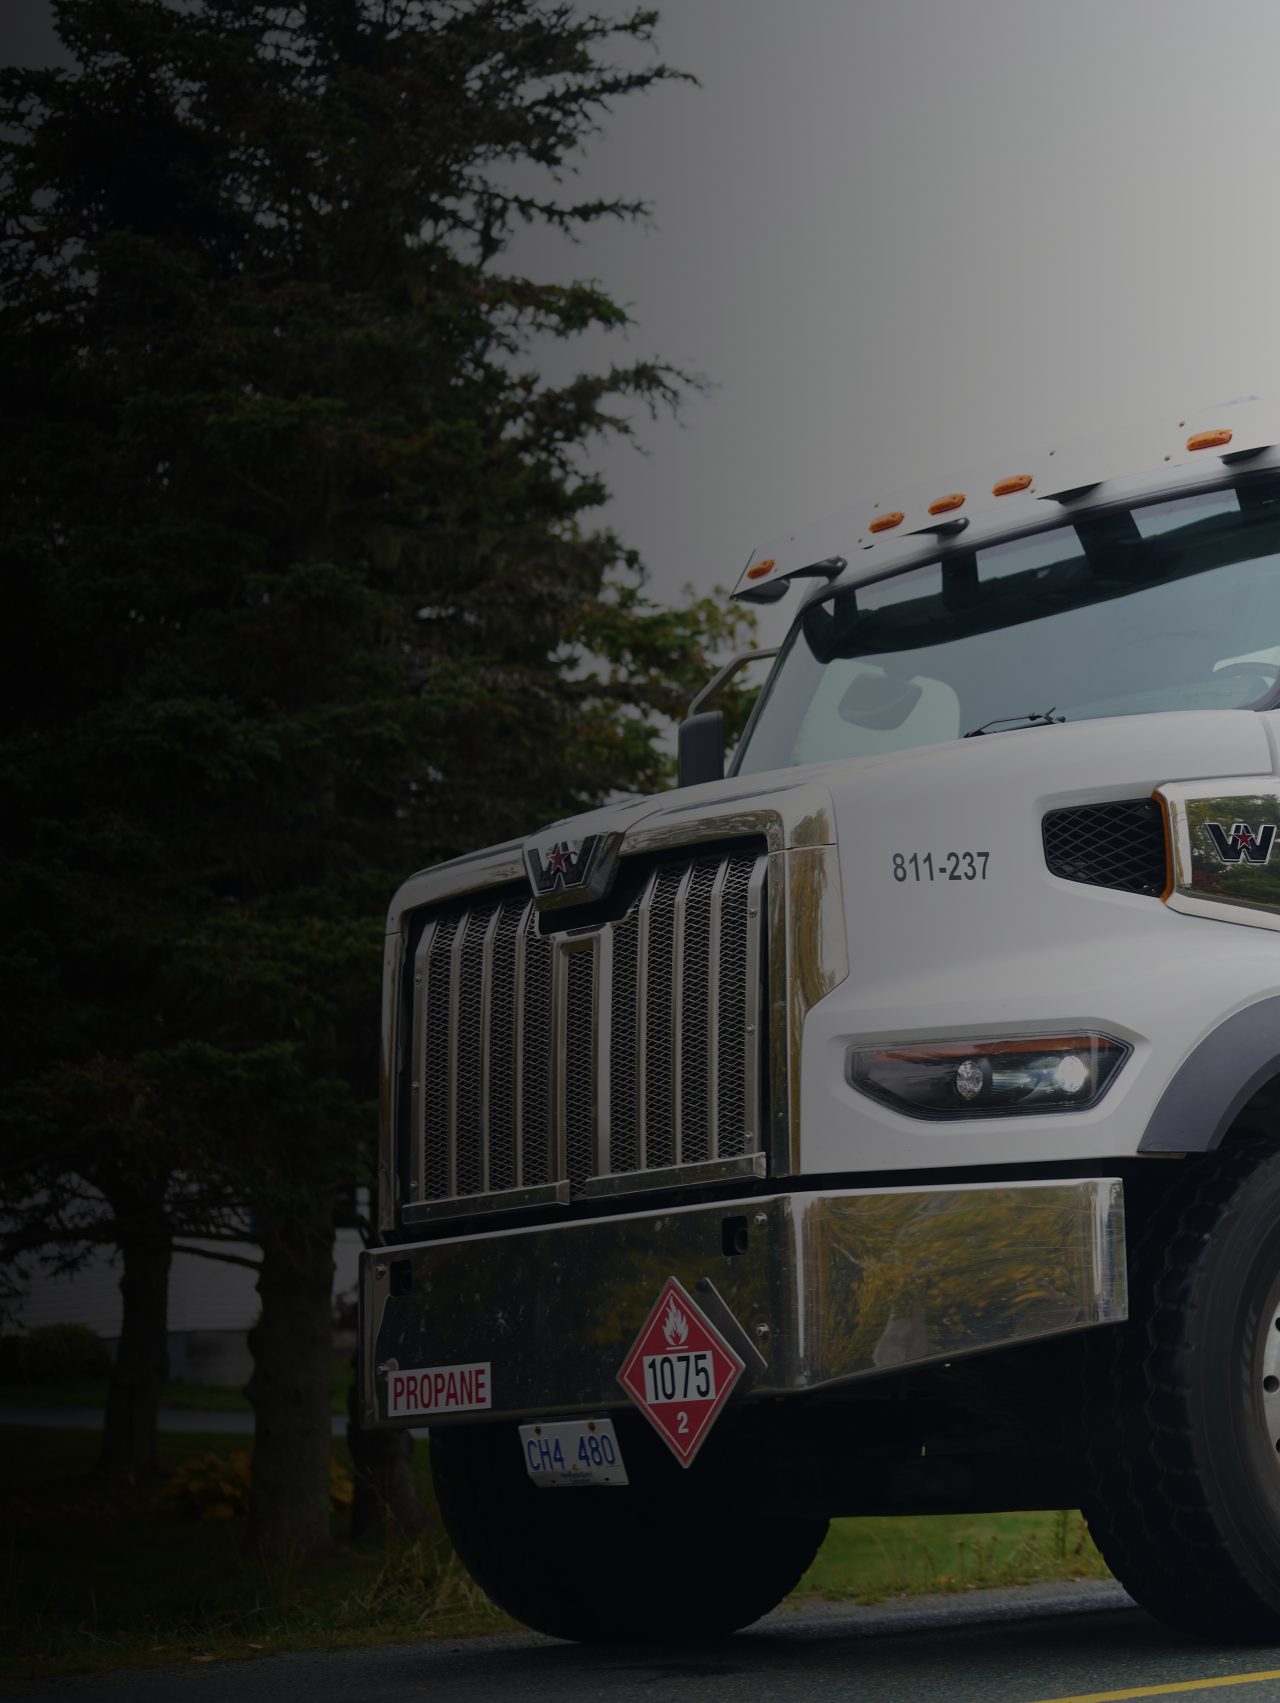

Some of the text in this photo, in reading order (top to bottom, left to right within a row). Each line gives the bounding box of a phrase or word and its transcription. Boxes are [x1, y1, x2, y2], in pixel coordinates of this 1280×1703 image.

[892, 851, 990, 883] 811-237
[393, 1368, 487, 1411] PROPANE
[647, 1353, 712, 1401] 1075
[676, 1411, 690, 1434] 2
[527, 1434, 616, 1471] CH4 480
